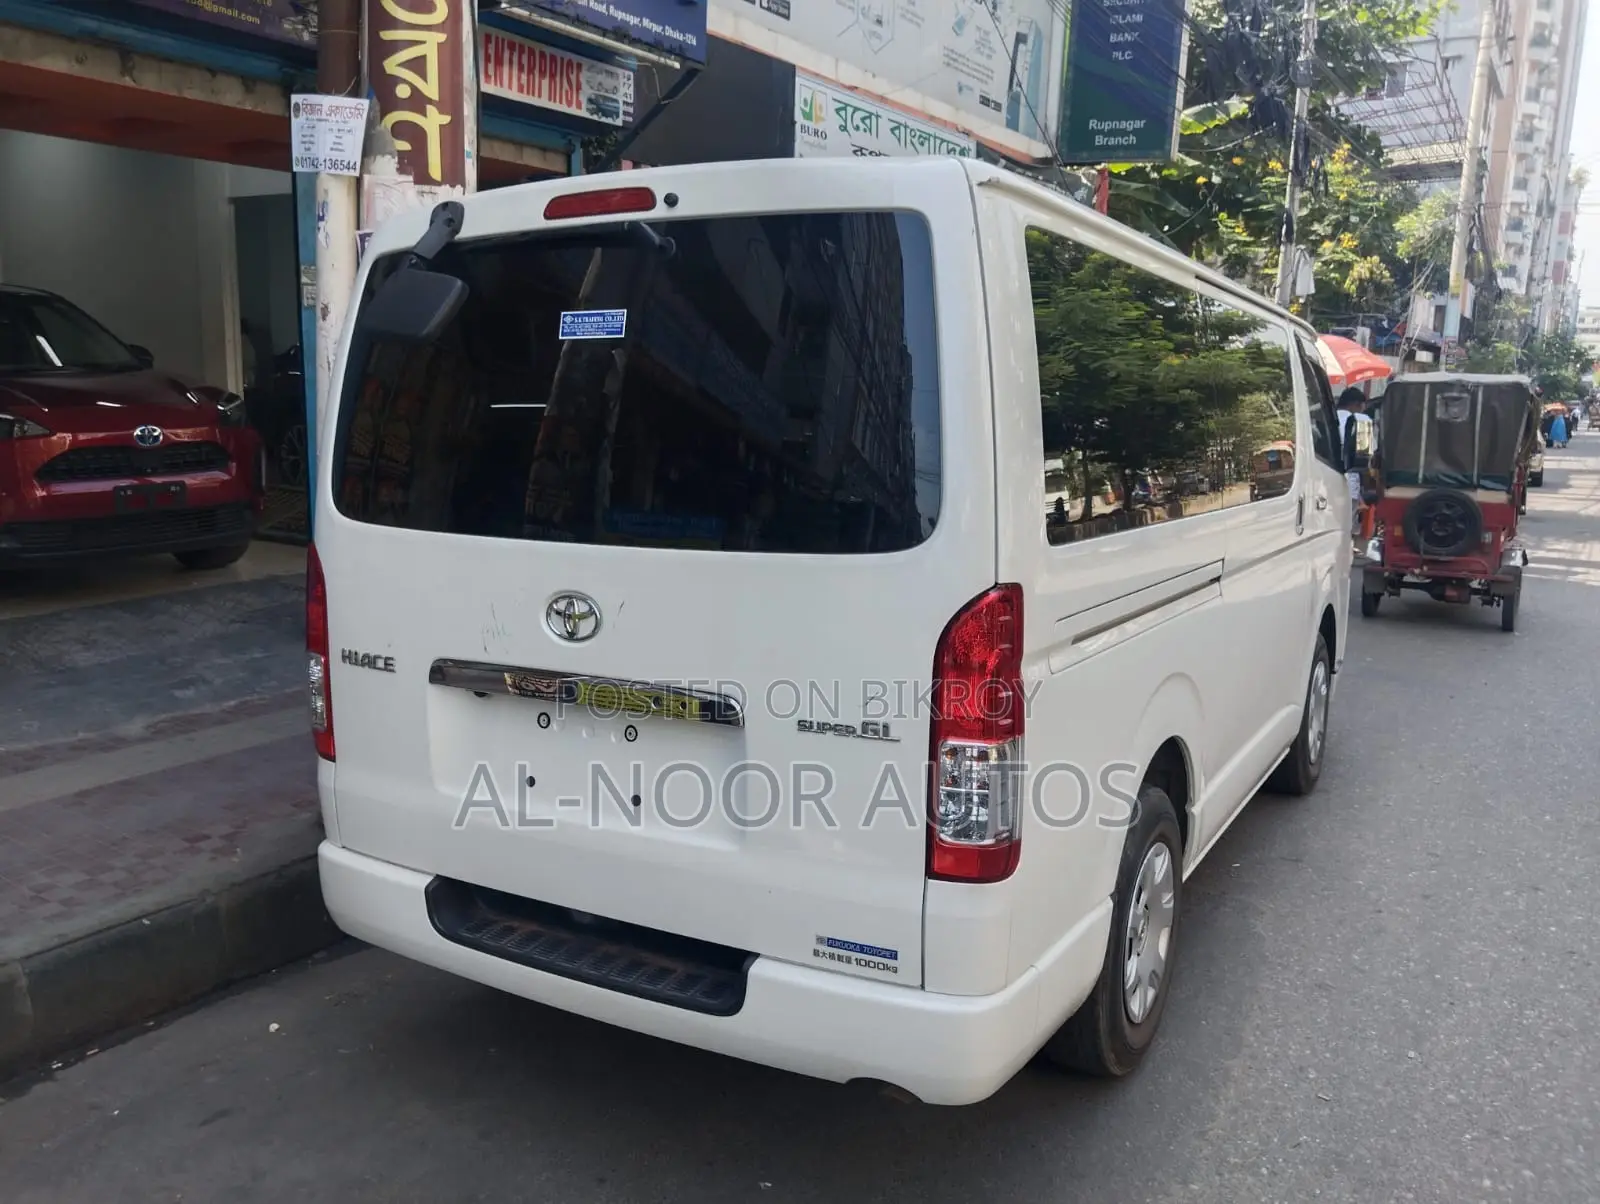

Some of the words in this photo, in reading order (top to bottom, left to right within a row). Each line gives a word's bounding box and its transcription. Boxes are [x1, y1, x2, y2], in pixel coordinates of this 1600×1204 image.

[589, 0, 609, 16] Road,
[609, 4, 642, 26] Rupnagar,
[642, 17, 664, 36] Mirpur,
[1109, 32, 1140, 43] BANK
[1112, 51, 1133, 60] PLC
[484, 32, 583, 112] ENTERPRISE
[832, 97, 882, 139] বুরো
[1088, 119, 1147, 132] Rupnagar
[800, 123, 828, 141] BURO
[1094, 134, 1137, 146] Branch
[300, 156, 357, 173] 01742-136544
[797, 719, 856, 737] SUPER
[857, 719, 901, 742] GL
[828, 939, 860, 951] FUKUOKA
[862, 945, 897, 961] TOYOPET
[854, 956, 898, 974] 1000kg
